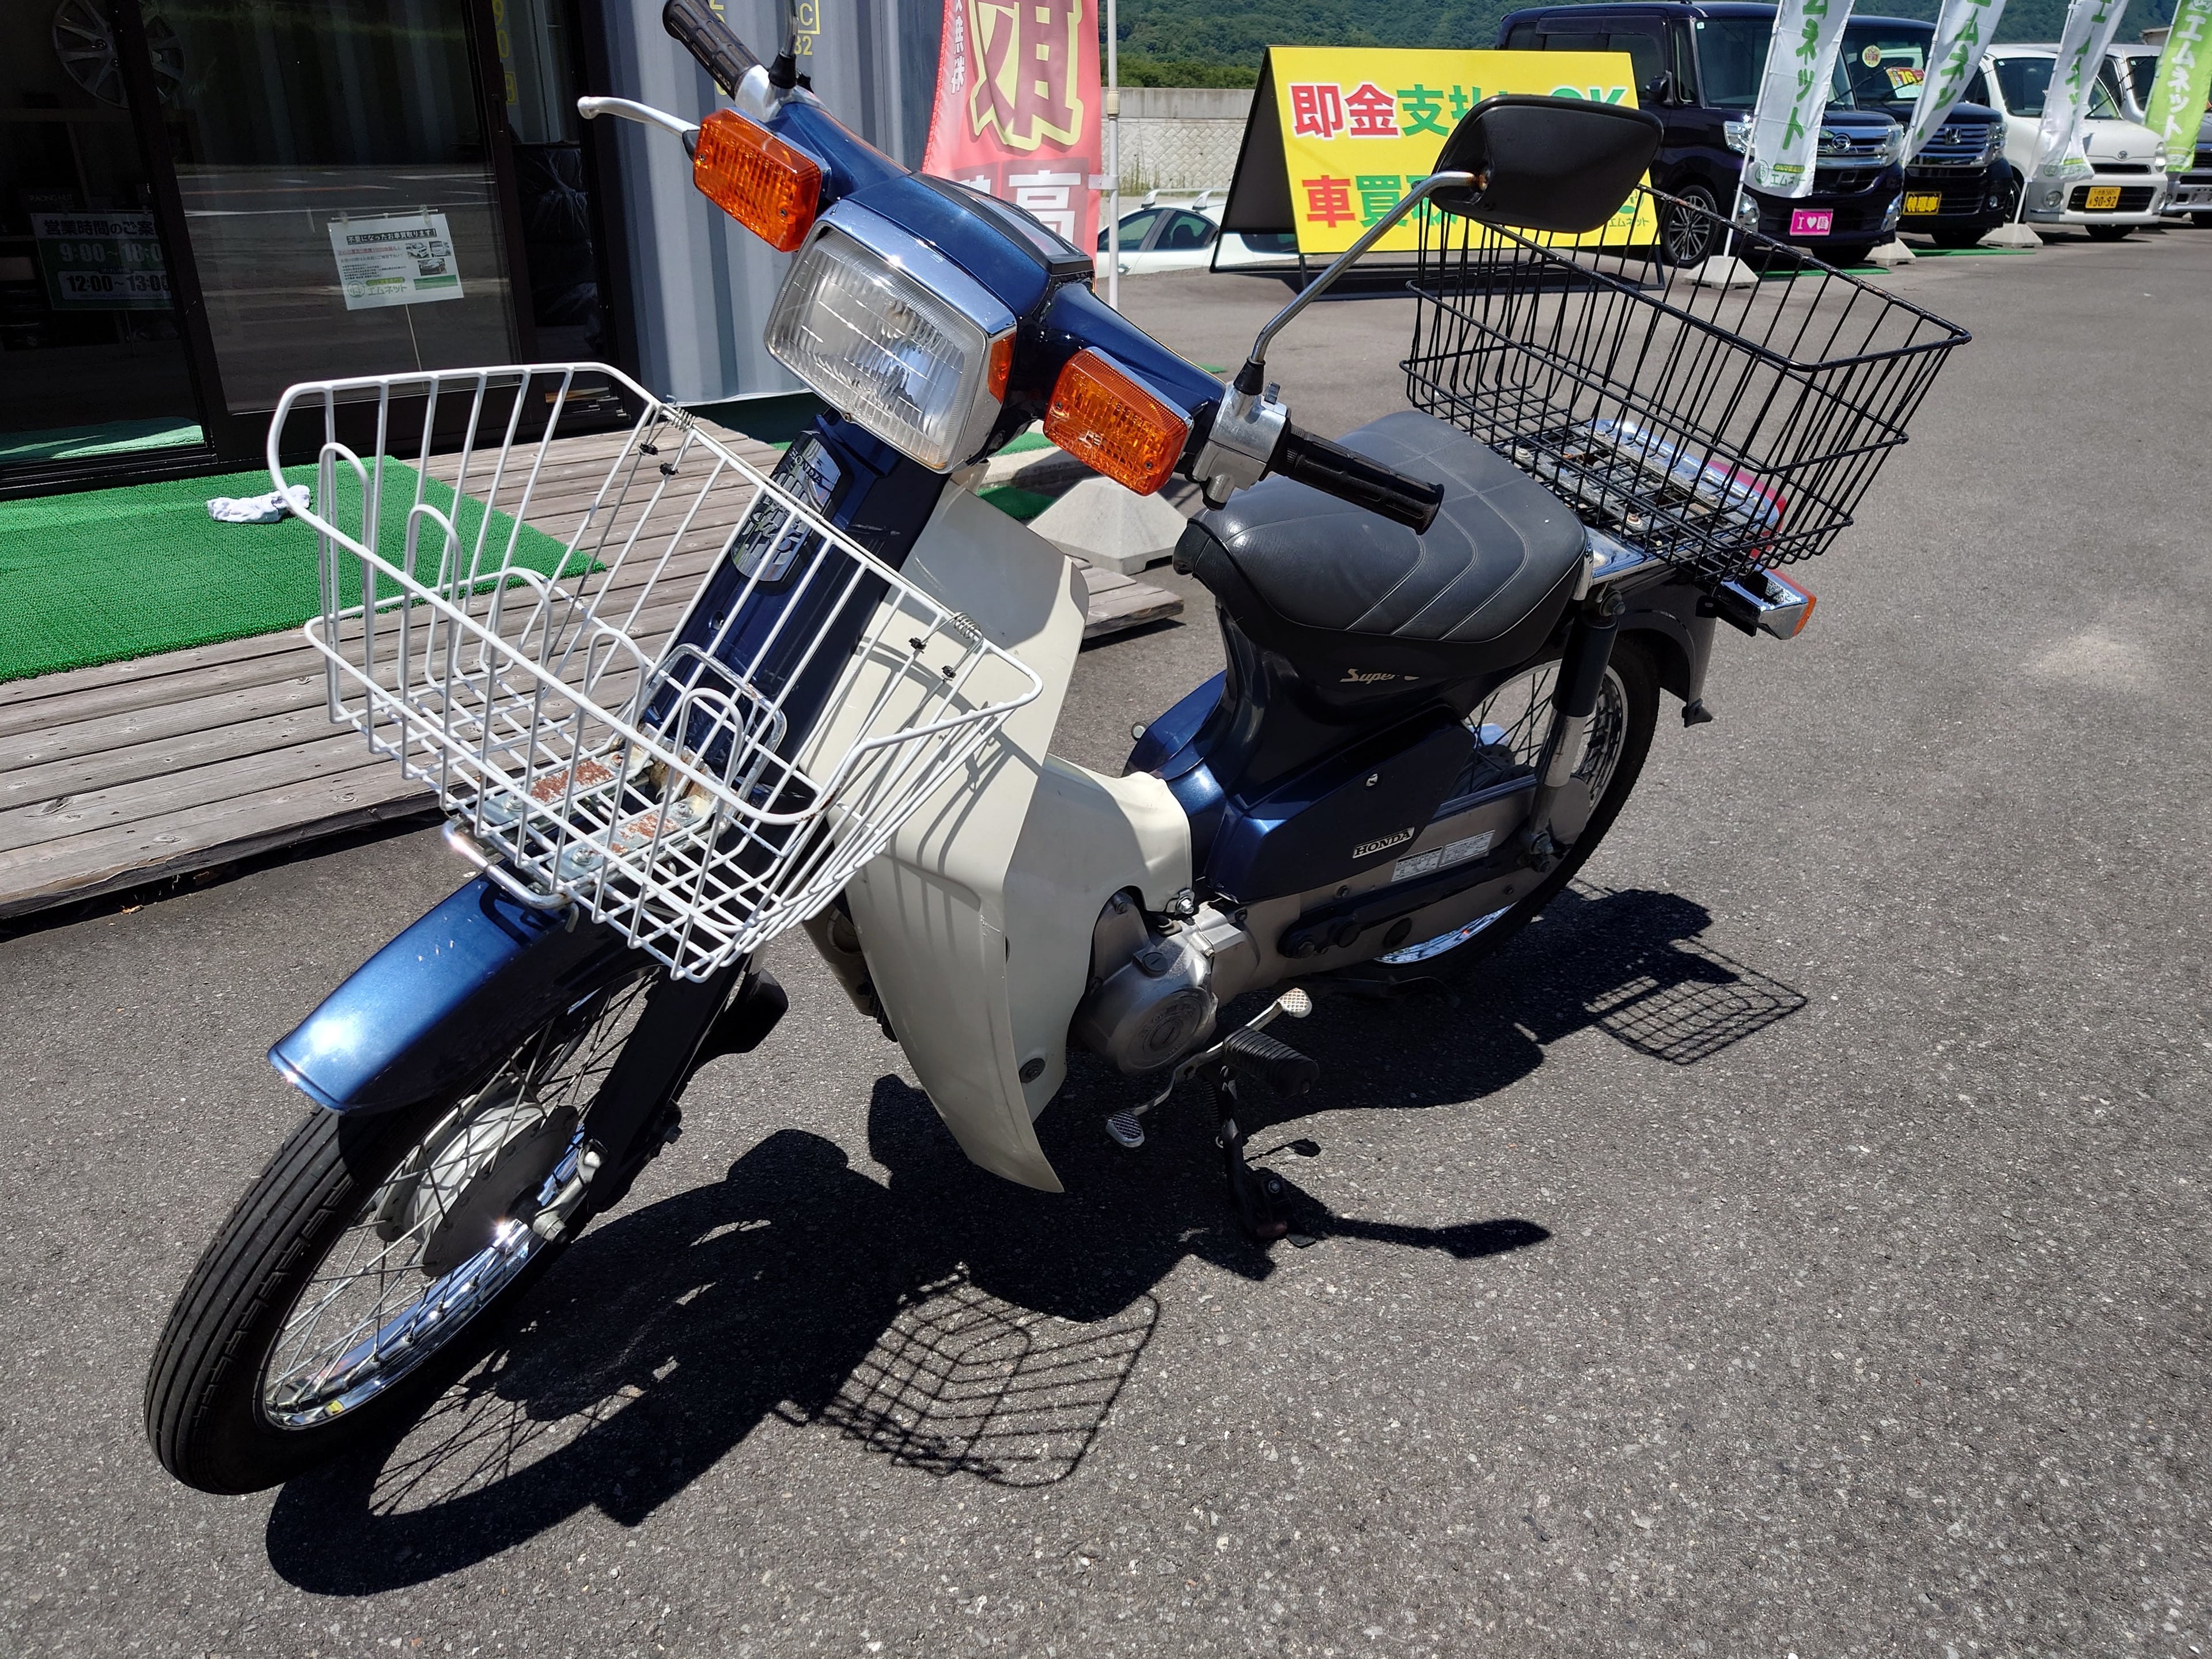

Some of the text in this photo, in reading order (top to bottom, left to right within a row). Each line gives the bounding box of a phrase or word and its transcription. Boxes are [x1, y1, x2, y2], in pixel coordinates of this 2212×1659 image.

[2164, 14, 2207, 142] エムネット
[44, 219, 156, 236] 営業時間のご案
[367, 284, 407, 297] エムネット
[789, 446, 824, 487] HONDA
[1355, 830, 1411, 857] HONDA
